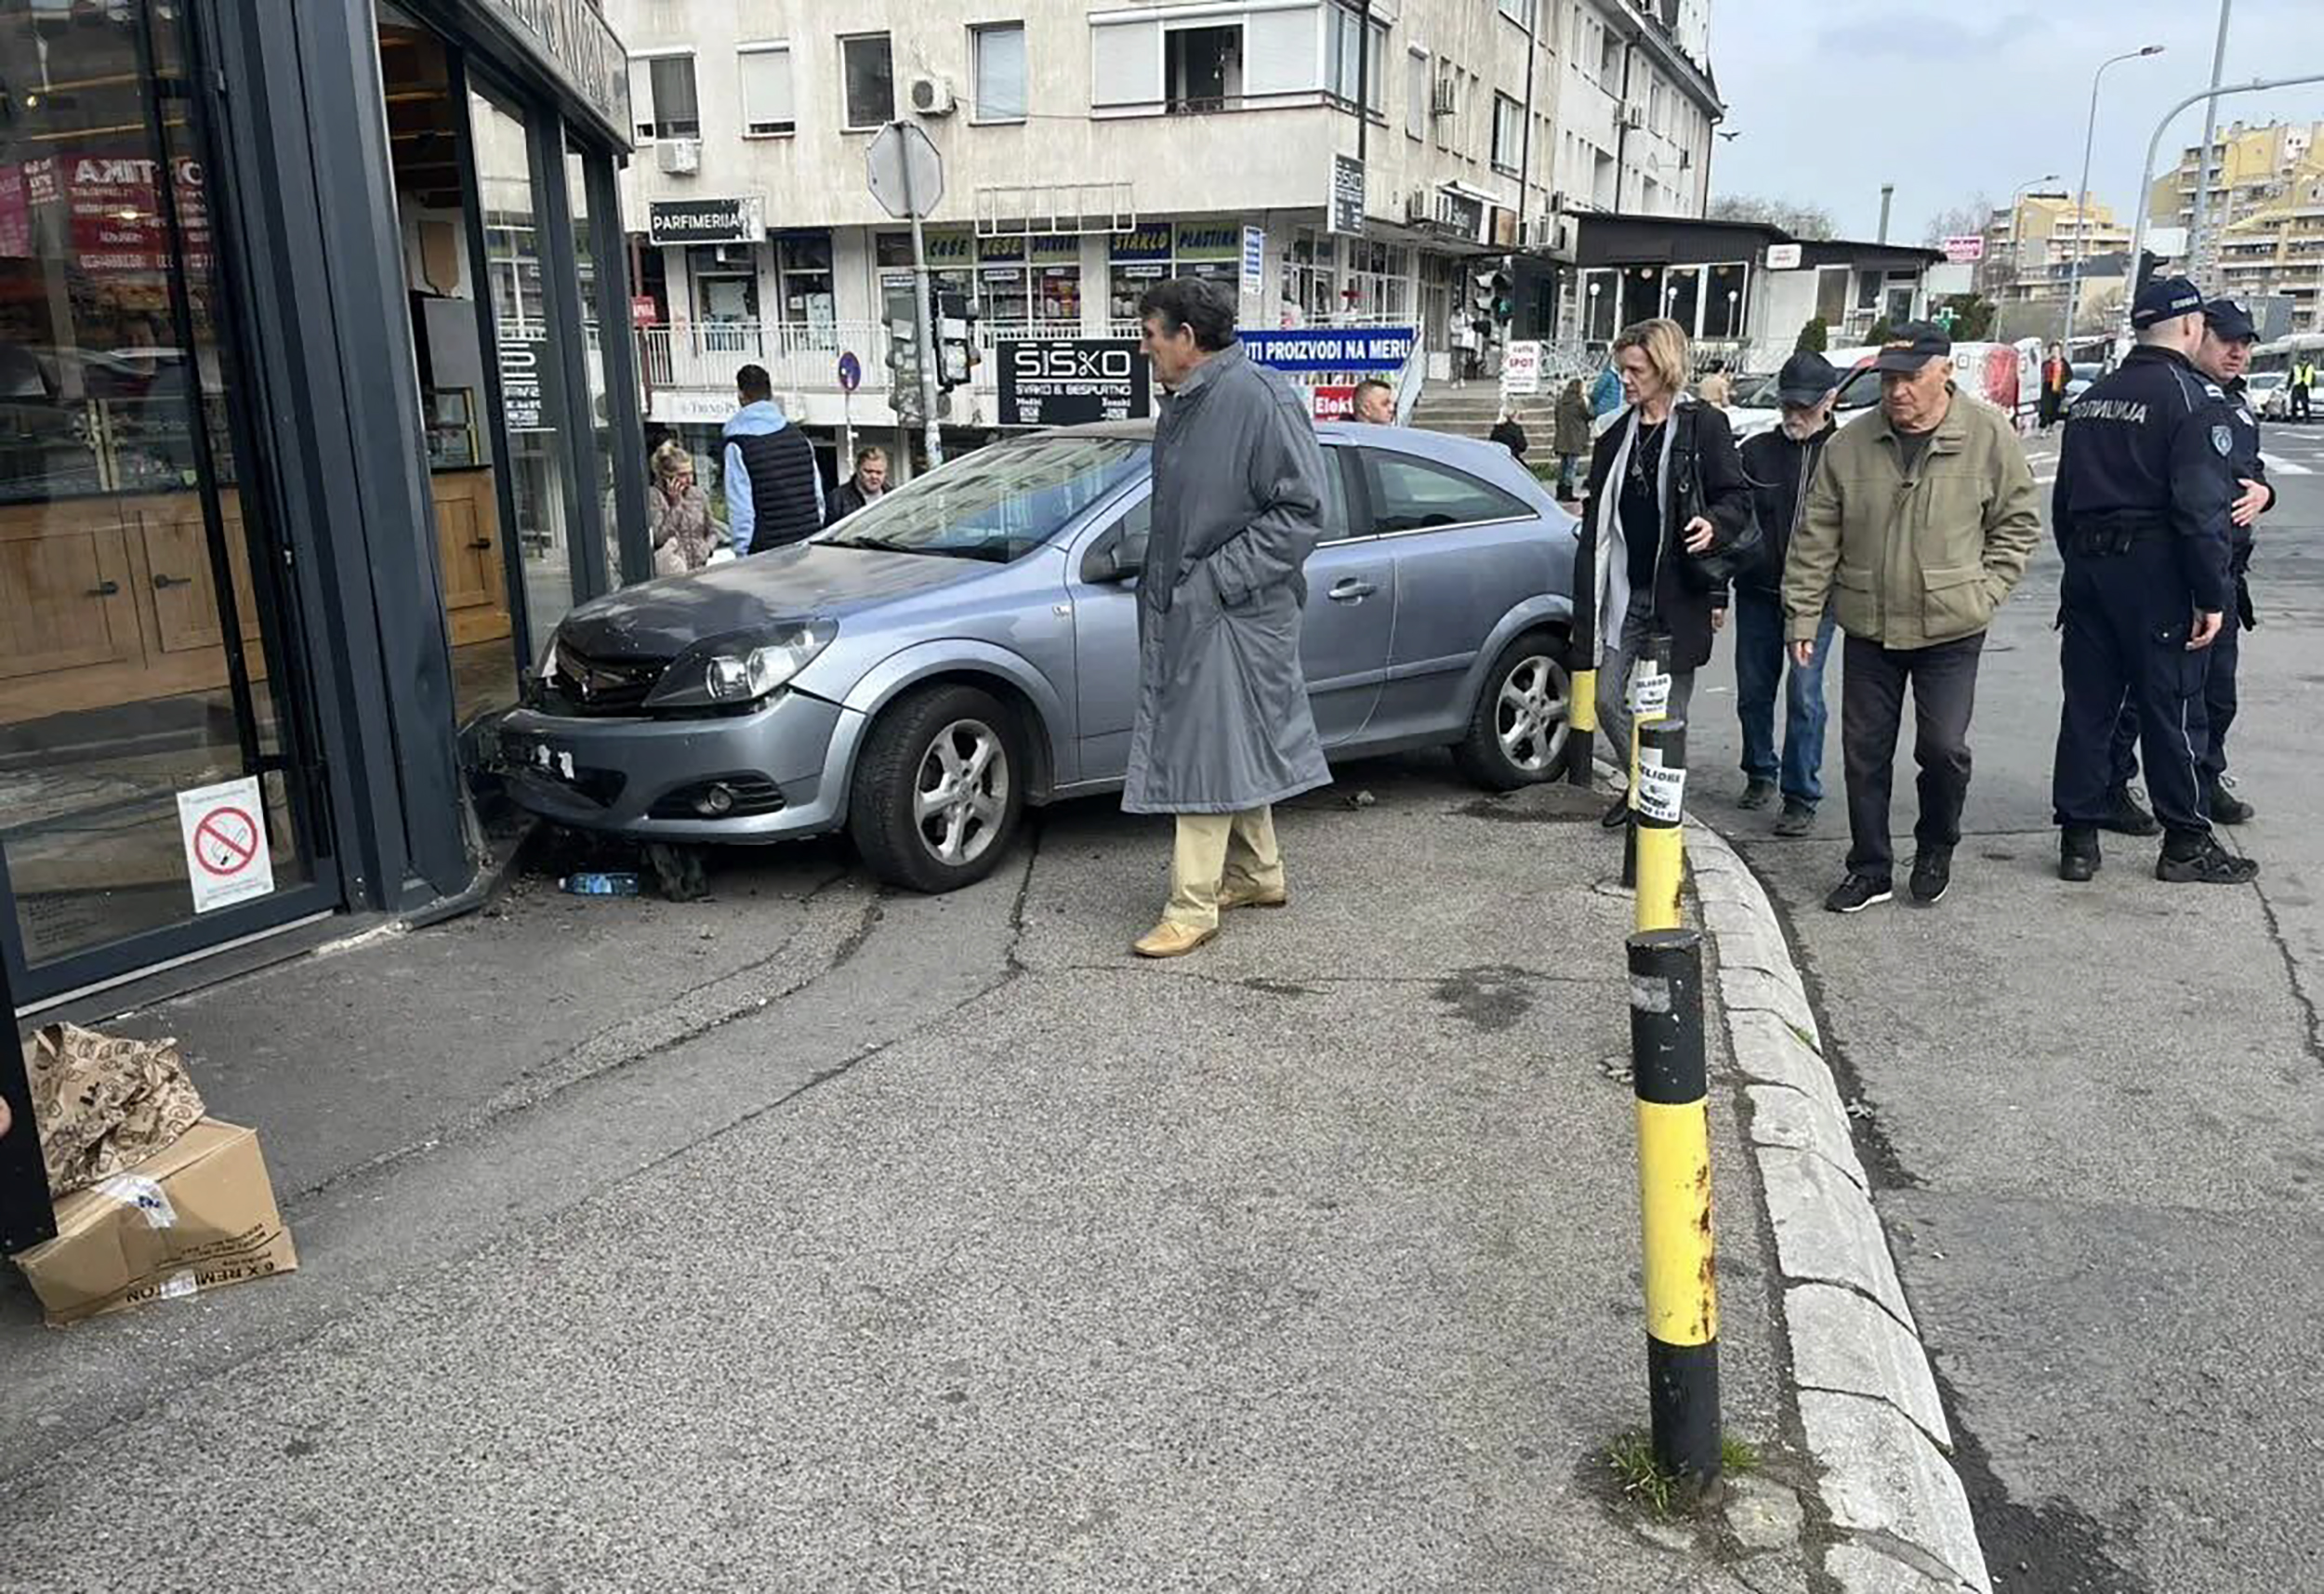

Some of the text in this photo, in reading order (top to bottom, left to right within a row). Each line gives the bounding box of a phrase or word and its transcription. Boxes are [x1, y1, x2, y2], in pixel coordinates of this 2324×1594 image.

[653, 214, 741, 230] PARFIMERIJA
[1114, 231, 1168, 251] STAKLO
[1265, 341, 1342, 361] PROIZVODI
[1345, 341, 1366, 360] NA
[1368, 339, 1411, 359] MERU
[1510, 358, 1533, 367] SPOT
[1065, 384, 1131, 395] BESPLATNO
